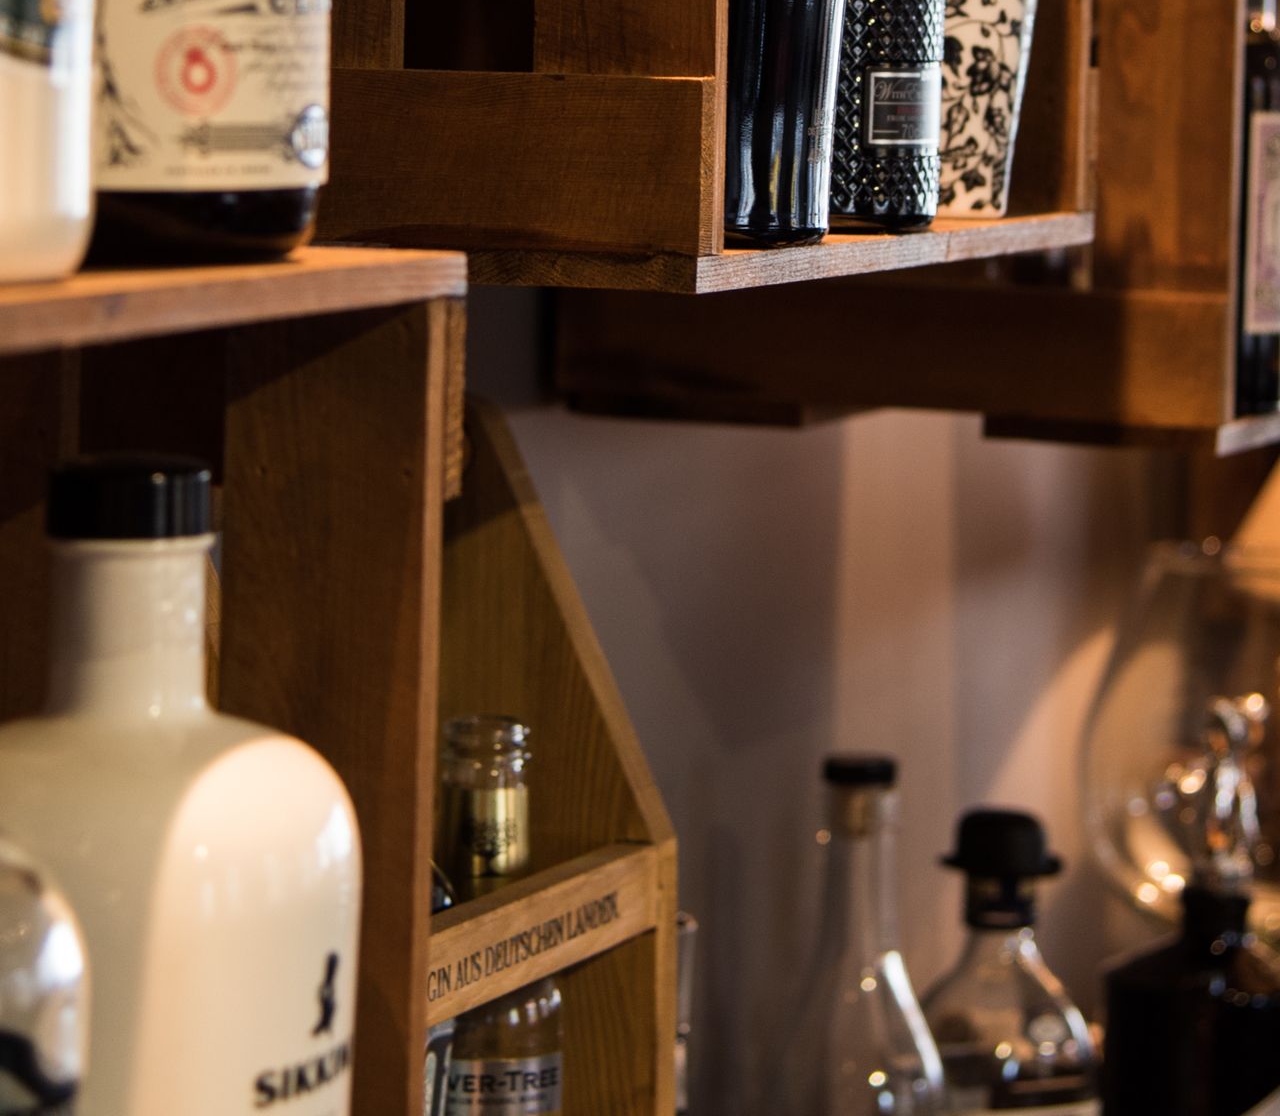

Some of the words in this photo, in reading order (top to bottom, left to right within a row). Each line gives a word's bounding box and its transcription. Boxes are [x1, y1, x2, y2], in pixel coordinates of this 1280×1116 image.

[426, 963, 453, 1003] GIN
[455, 949, 482, 991] AUS
[485, 913, 567, 977] DEUTSCHEN
